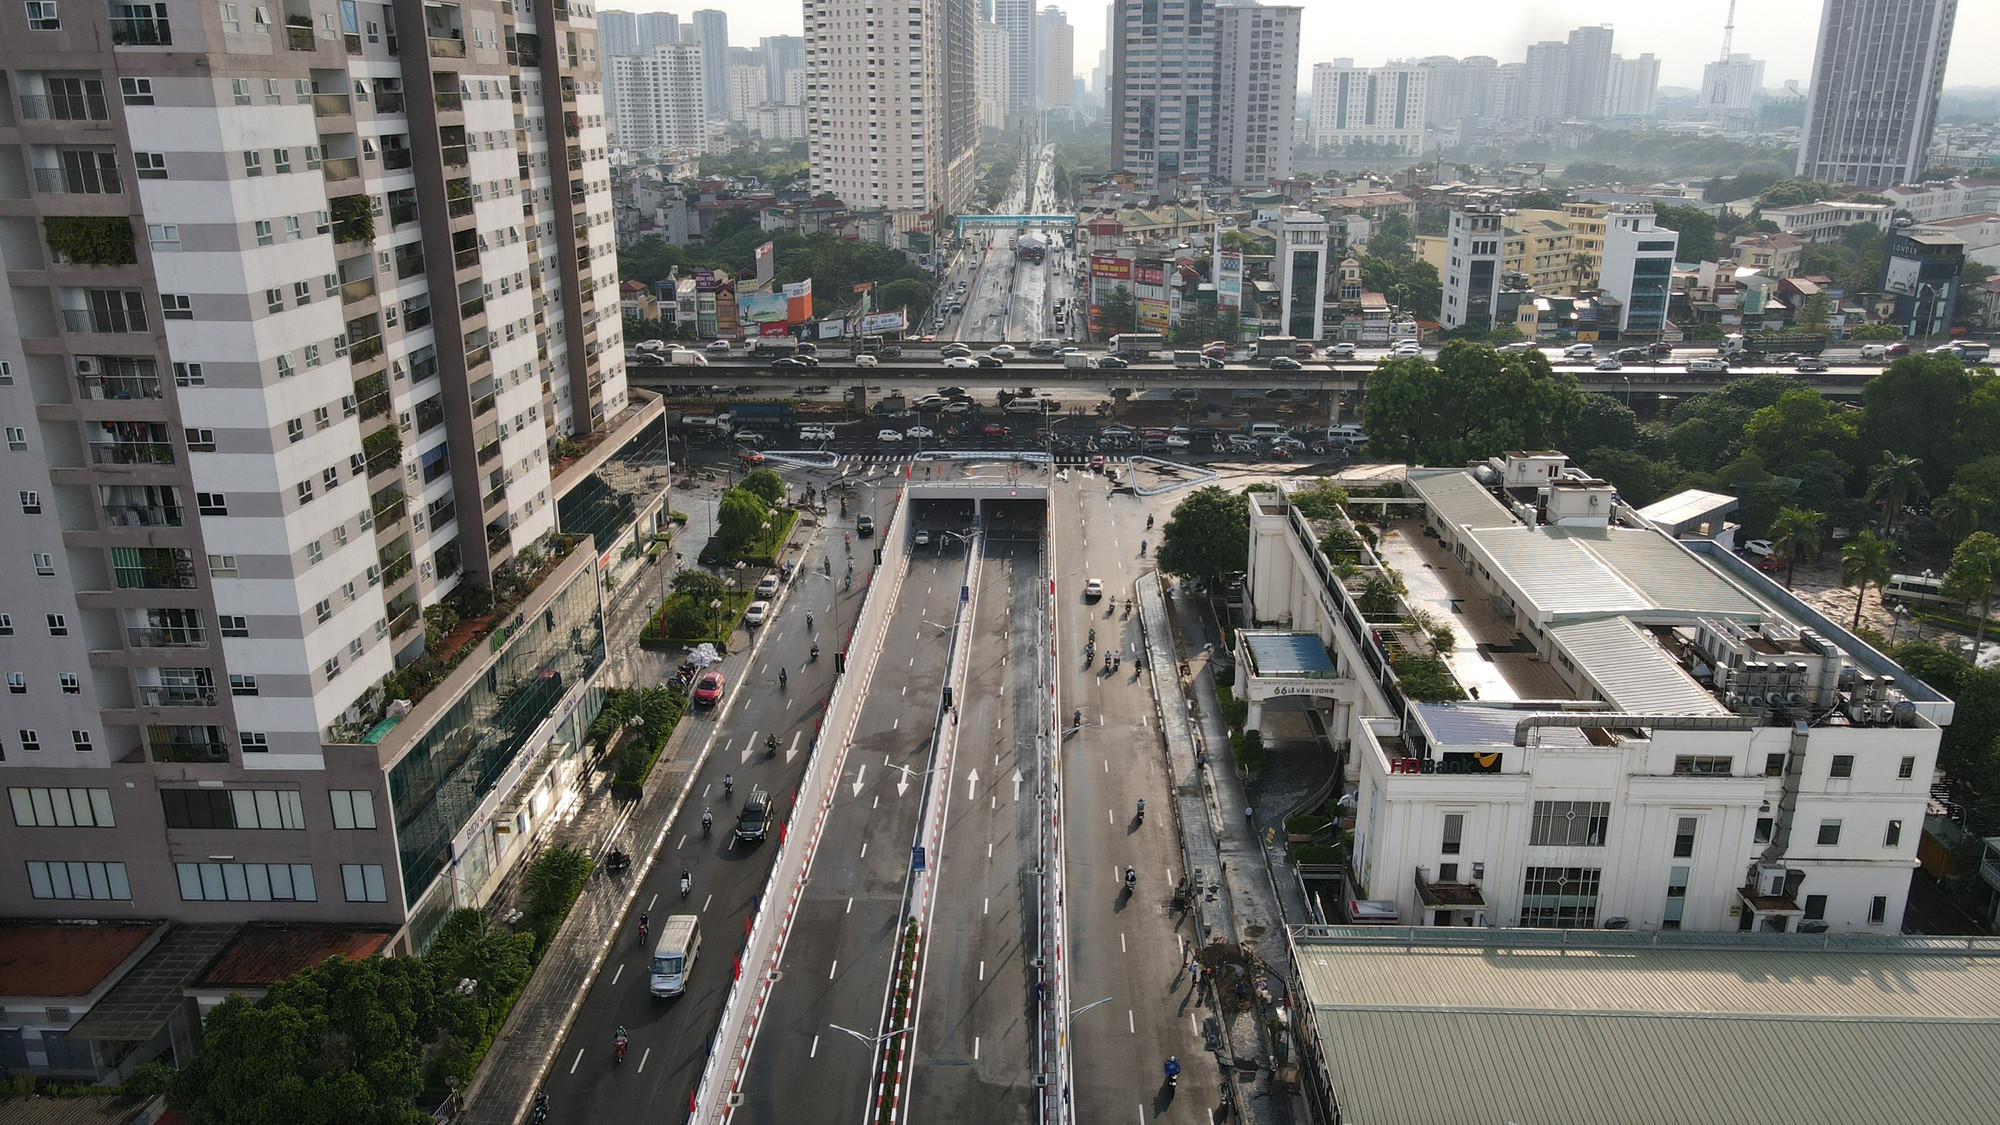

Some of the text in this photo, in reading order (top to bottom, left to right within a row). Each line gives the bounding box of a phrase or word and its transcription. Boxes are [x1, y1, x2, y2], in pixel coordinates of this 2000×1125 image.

[1892, 244, 1917, 254] SONDER
[1274, 686, 1287, 694] 66
[1288, 686, 1295, 694] LÊ
[1296, 686, 1310, 694] VĂN
[564, 700, 572, 714] BIDV
[519, 752, 530, 772] BIDV
[1390, 757, 1474, 774] HDBank
[466, 816, 480, 840] BIDV
